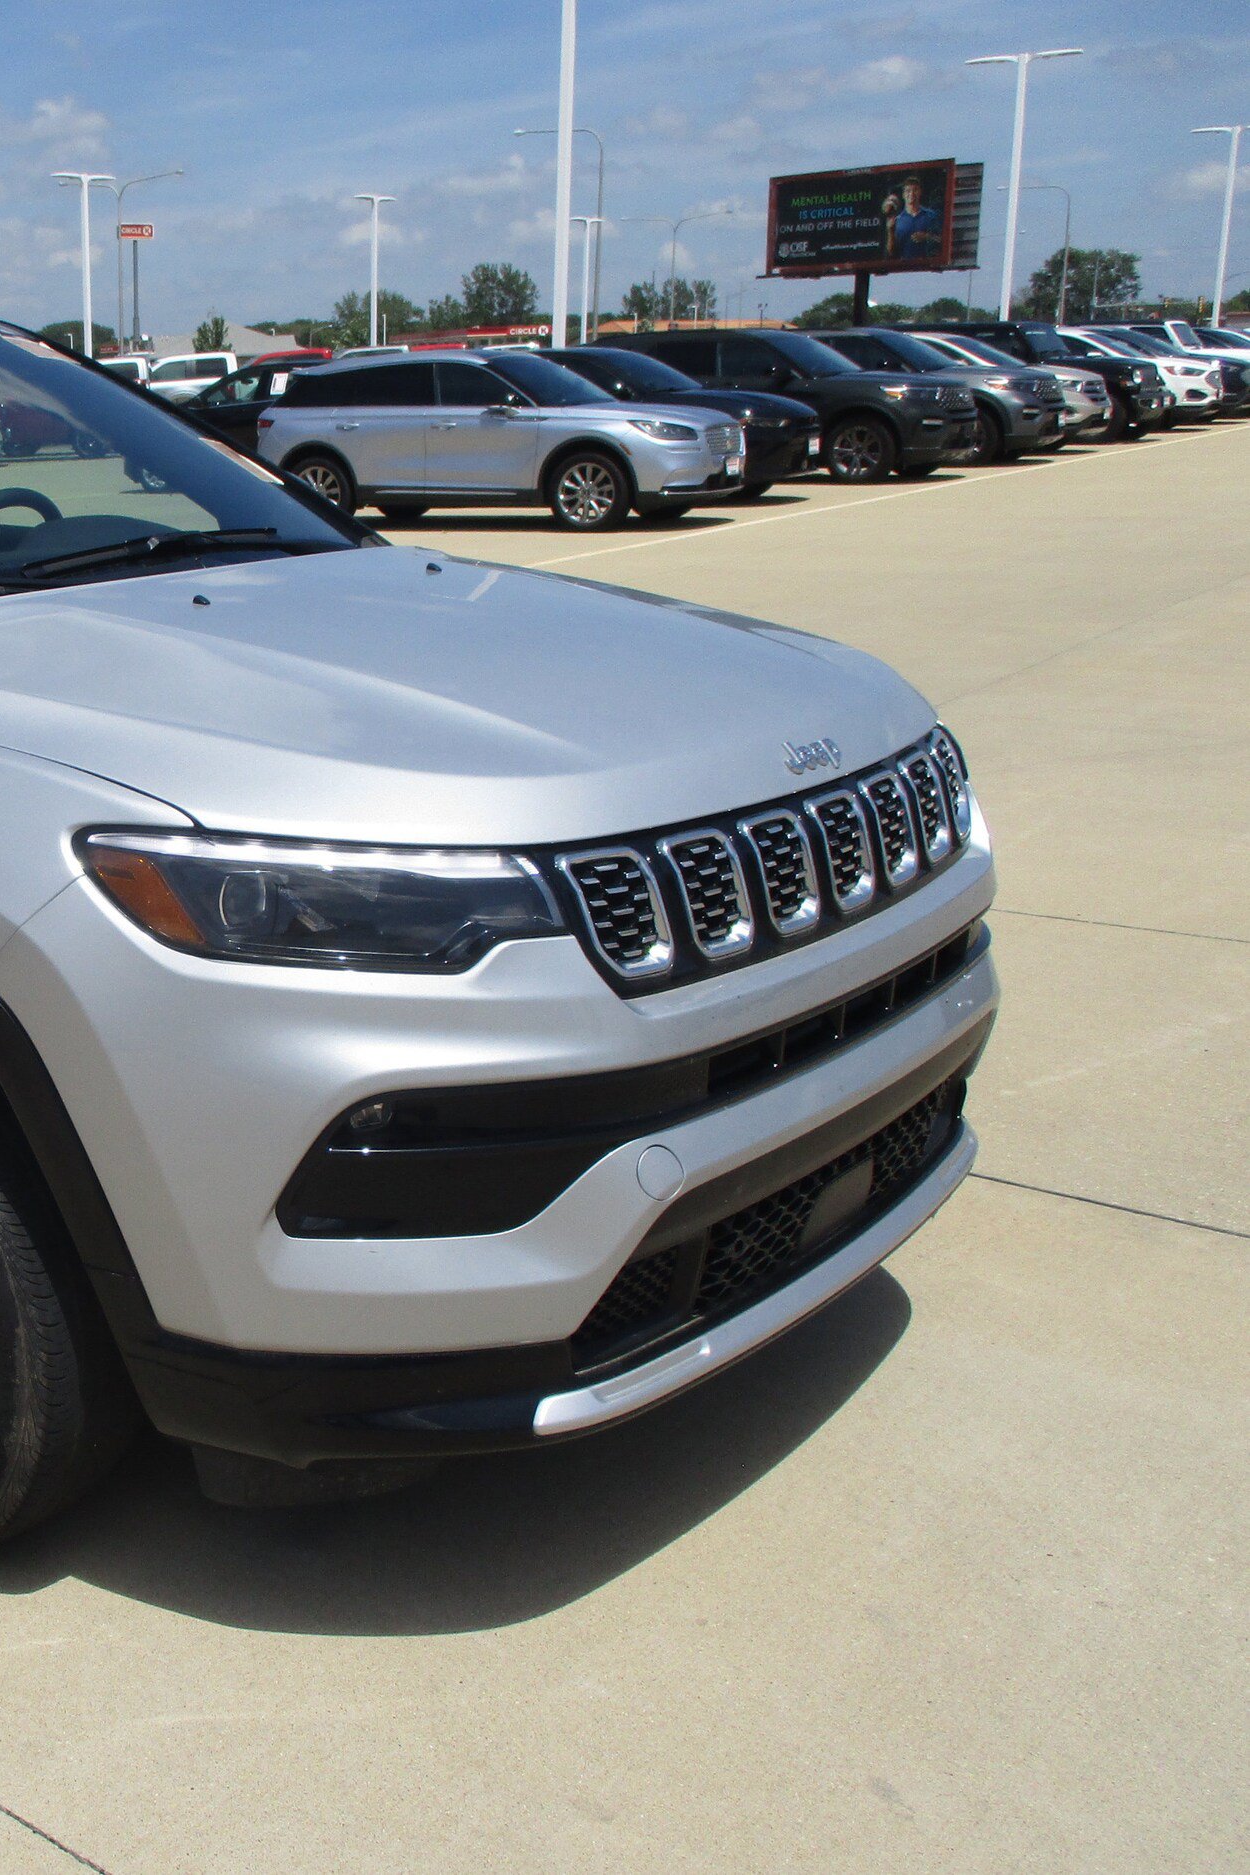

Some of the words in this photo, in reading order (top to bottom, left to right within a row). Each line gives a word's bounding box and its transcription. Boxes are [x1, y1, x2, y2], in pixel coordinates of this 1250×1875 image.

[791, 195, 830, 207] MENTAL
[833, 191, 872, 203] HEALTH
[799, 210, 808, 220] IS
[810, 207, 854, 219] CRITICAL
[779, 225, 793, 234] ON
[795, 223, 814, 232] AND
[817, 221, 833, 231] OFF
[836, 219, 852, 229] THE
[855, 217, 880, 227] FIELD
[510, 327, 536, 335] CIRCLE
[781, 738, 841, 775] Jeep
